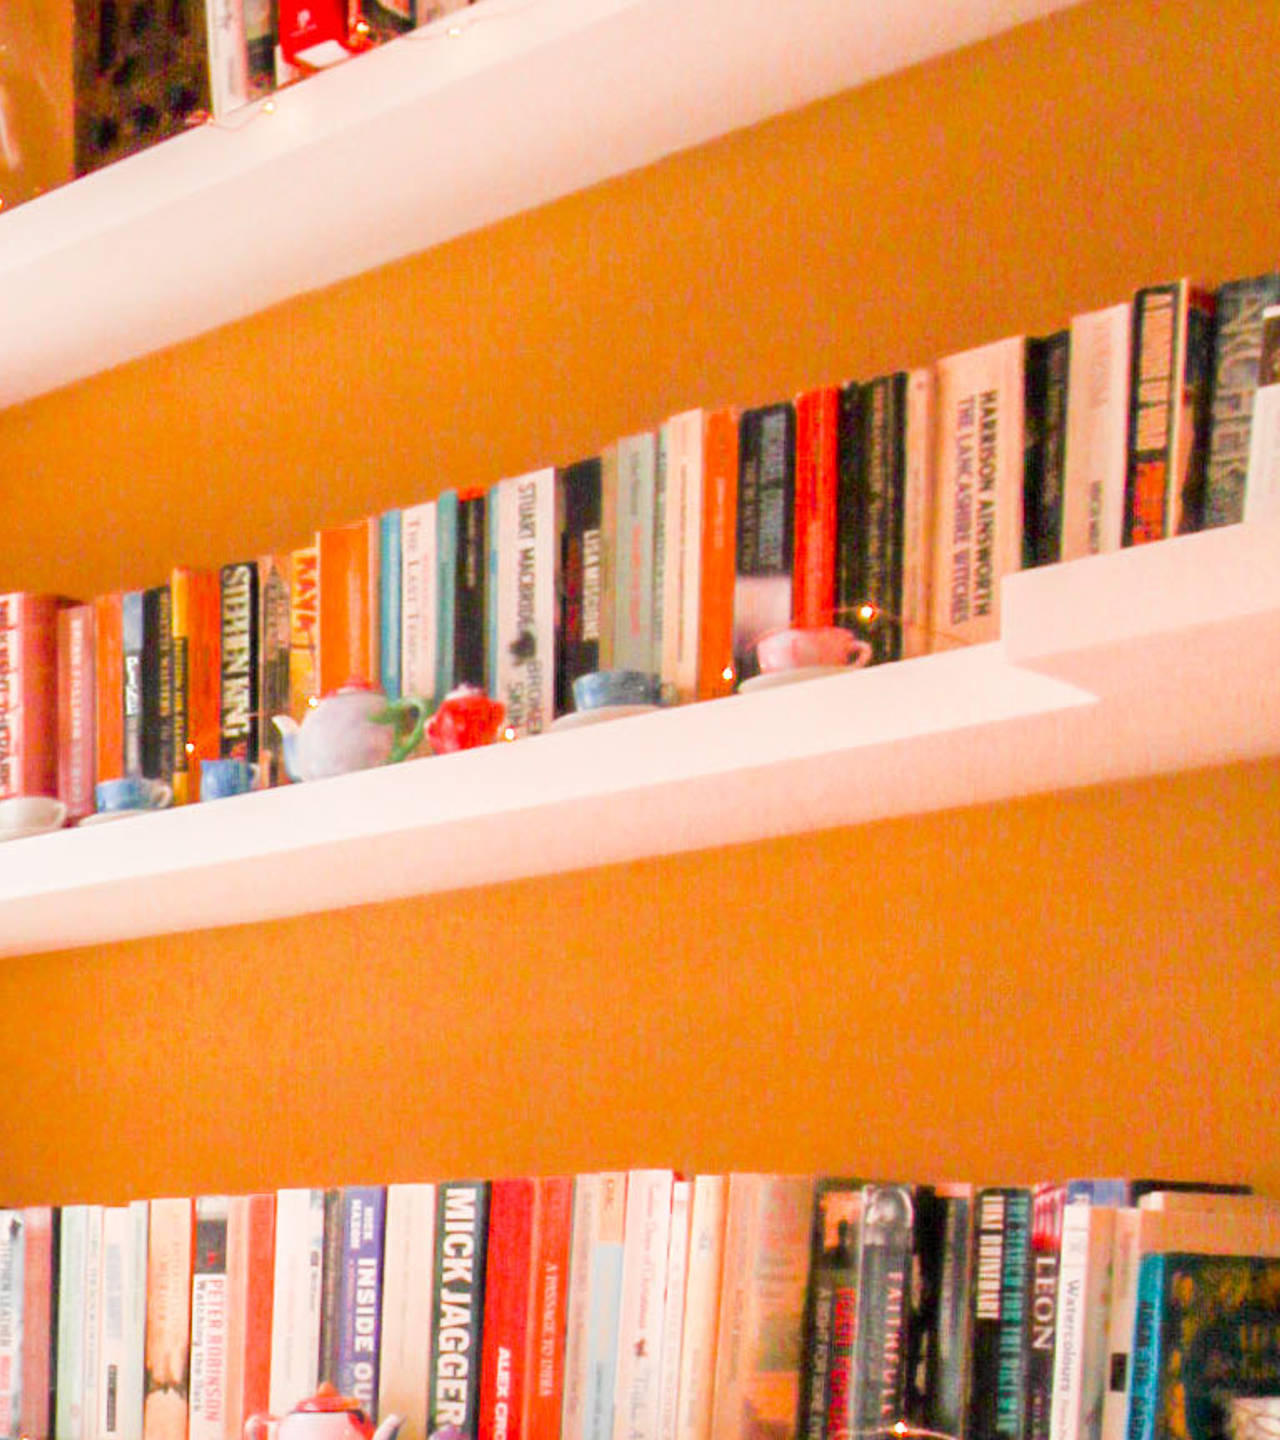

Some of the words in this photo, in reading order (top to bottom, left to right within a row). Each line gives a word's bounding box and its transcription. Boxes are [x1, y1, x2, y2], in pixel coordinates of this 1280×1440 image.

[958, 395, 974, 429] THE
[979, 390, 998, 492] HARRISON
[517, 482, 535, 541] STUART
[953, 434, 973, 544] LANCASHIRE
[515, 548, 535, 630] MACBRIDE
[952, 549, 970, 626] WITCHES
[973, 499, 995, 617] AINSWORTH
[222, 565, 251, 674] STEPHEN
[224, 676, 252, 737] KING
[0, 1239, 13, 1291] STEPHEN
[441, 1187, 477, 1284] MICK
[0, 1296, 12, 1347] LEATHER
[191, 1280, 205, 1348] Watching
[207, 1279, 224, 1329] PETER
[355, 1258, 377, 1353] INSIDE
[542, 1275, 557, 1334] PASSAGE
[1031, 1255, 1057, 1350] LEON
[1059, 1279, 1081, 1393] Watercolours
[193, 1353, 204, 1375] the
[204, 1334, 223, 1423] ROBINSON
[435, 1289, 472, 1426] JAGGER
[496, 1346, 511, 1398] ALEX
[539, 1359, 553, 1397] INDIA
[541, 1339, 554, 1356] TO
[881, 1271, 904, 1415] FAITHFULL
[192, 1380, 204, 1412] Dark
